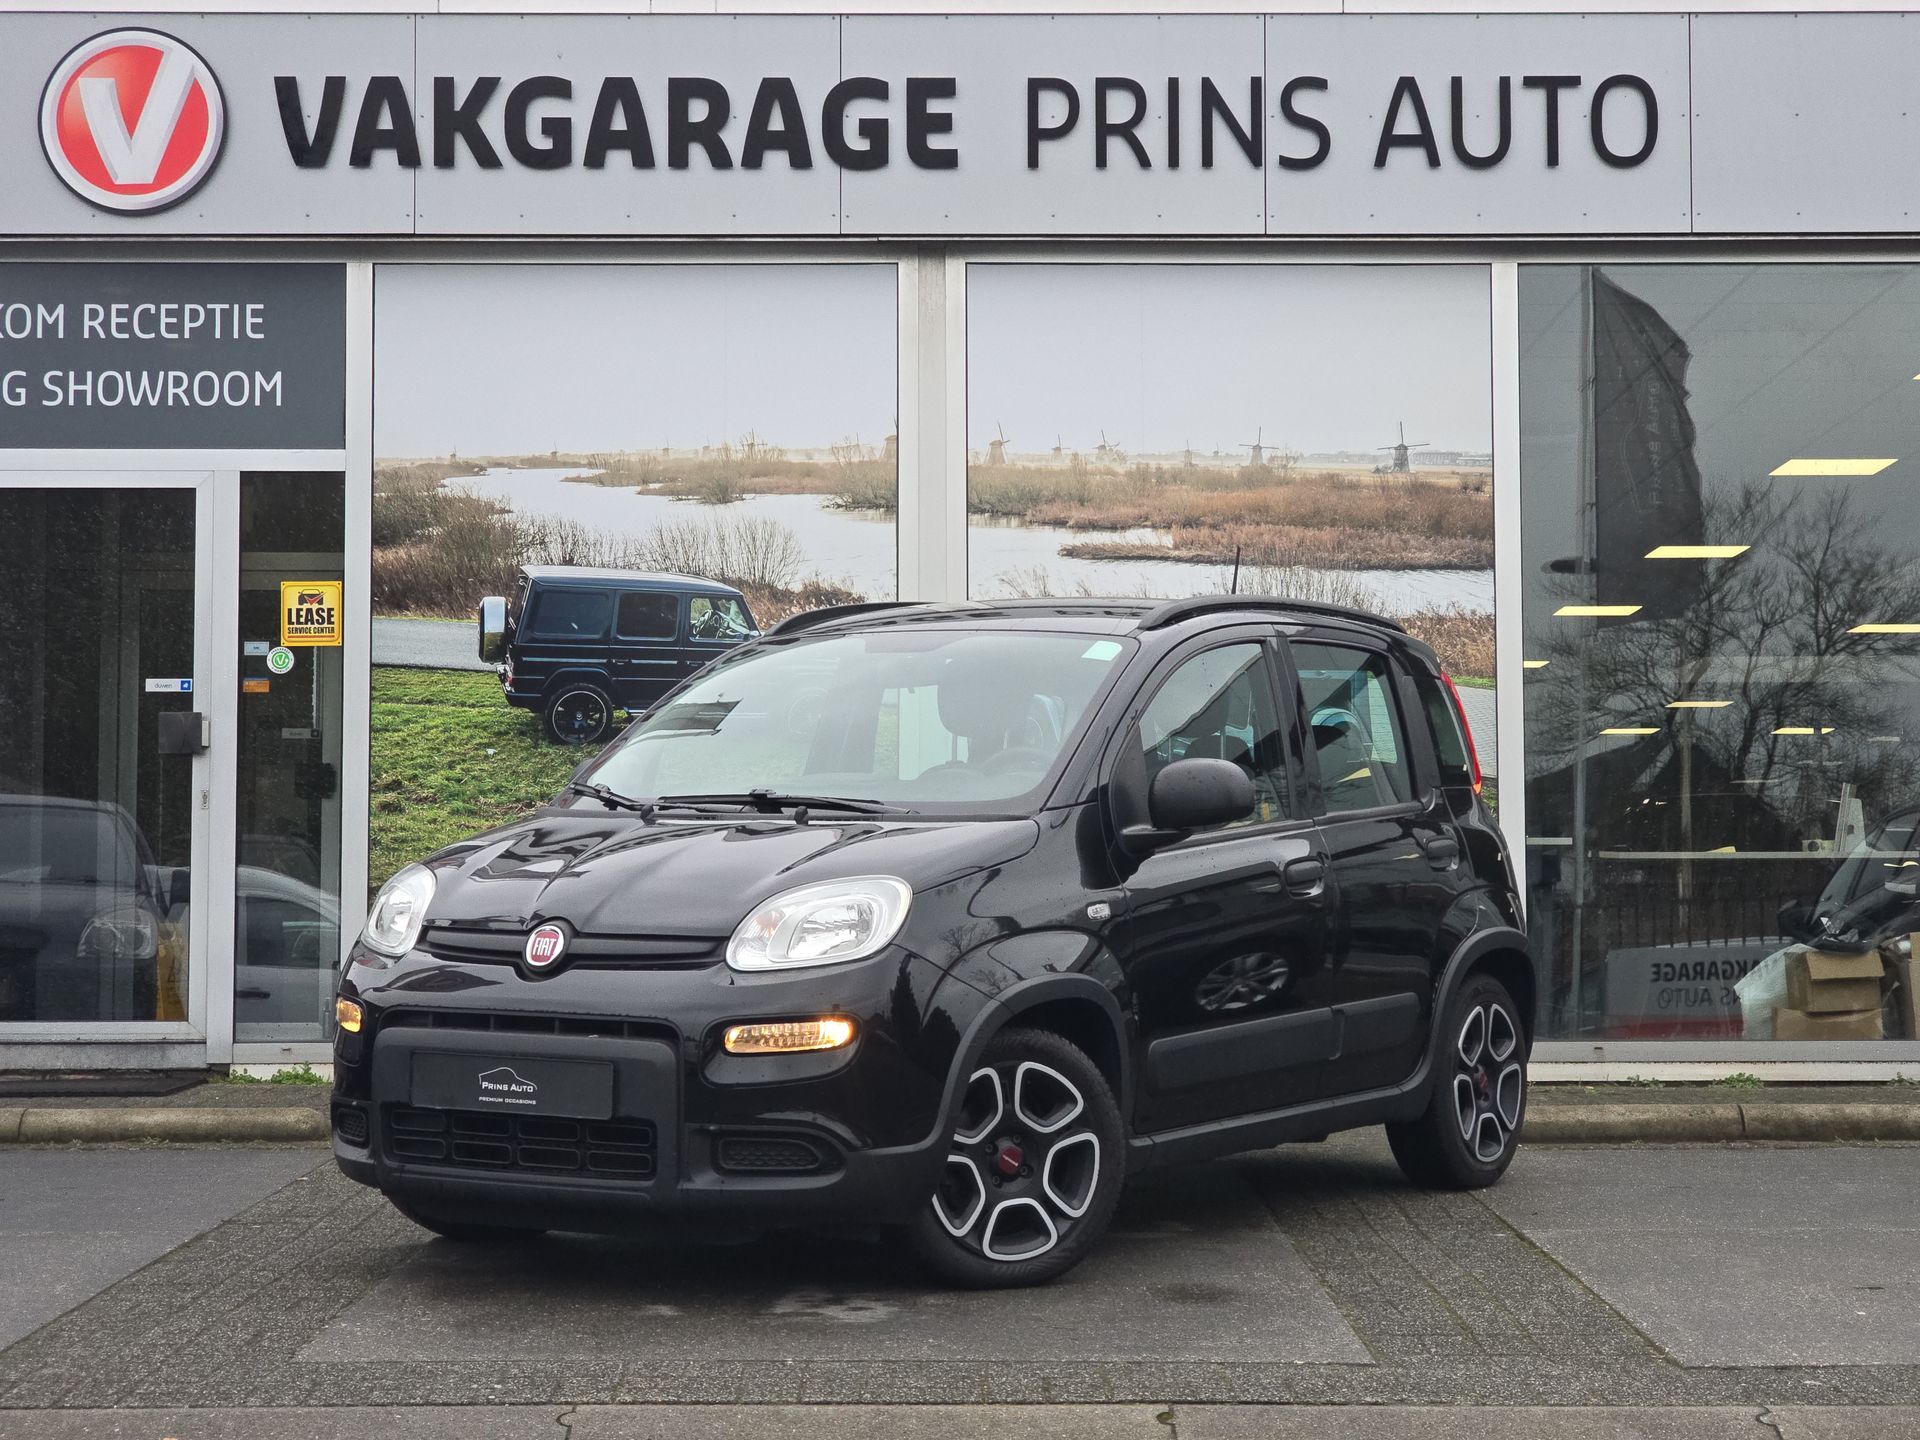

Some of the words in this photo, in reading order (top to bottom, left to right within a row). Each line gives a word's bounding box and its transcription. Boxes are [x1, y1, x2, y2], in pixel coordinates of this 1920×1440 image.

[274, 76, 958, 170] VAKGARAGE
[1028, 76, 1330, 169] PRINS
[1374, 75, 1658, 169] AUTO
[84, 303, 265, 339] RECEPTIE
[42, 370, 282, 406] SHOWROOM
[287, 607, 335, 625] LEASE
[287, 626, 312, 635] SERVICE
[313, 626, 335, 634] CENTER
[532, 937, 557, 957] FIAT
[504, 1097, 537, 1105] OCCASIONS
